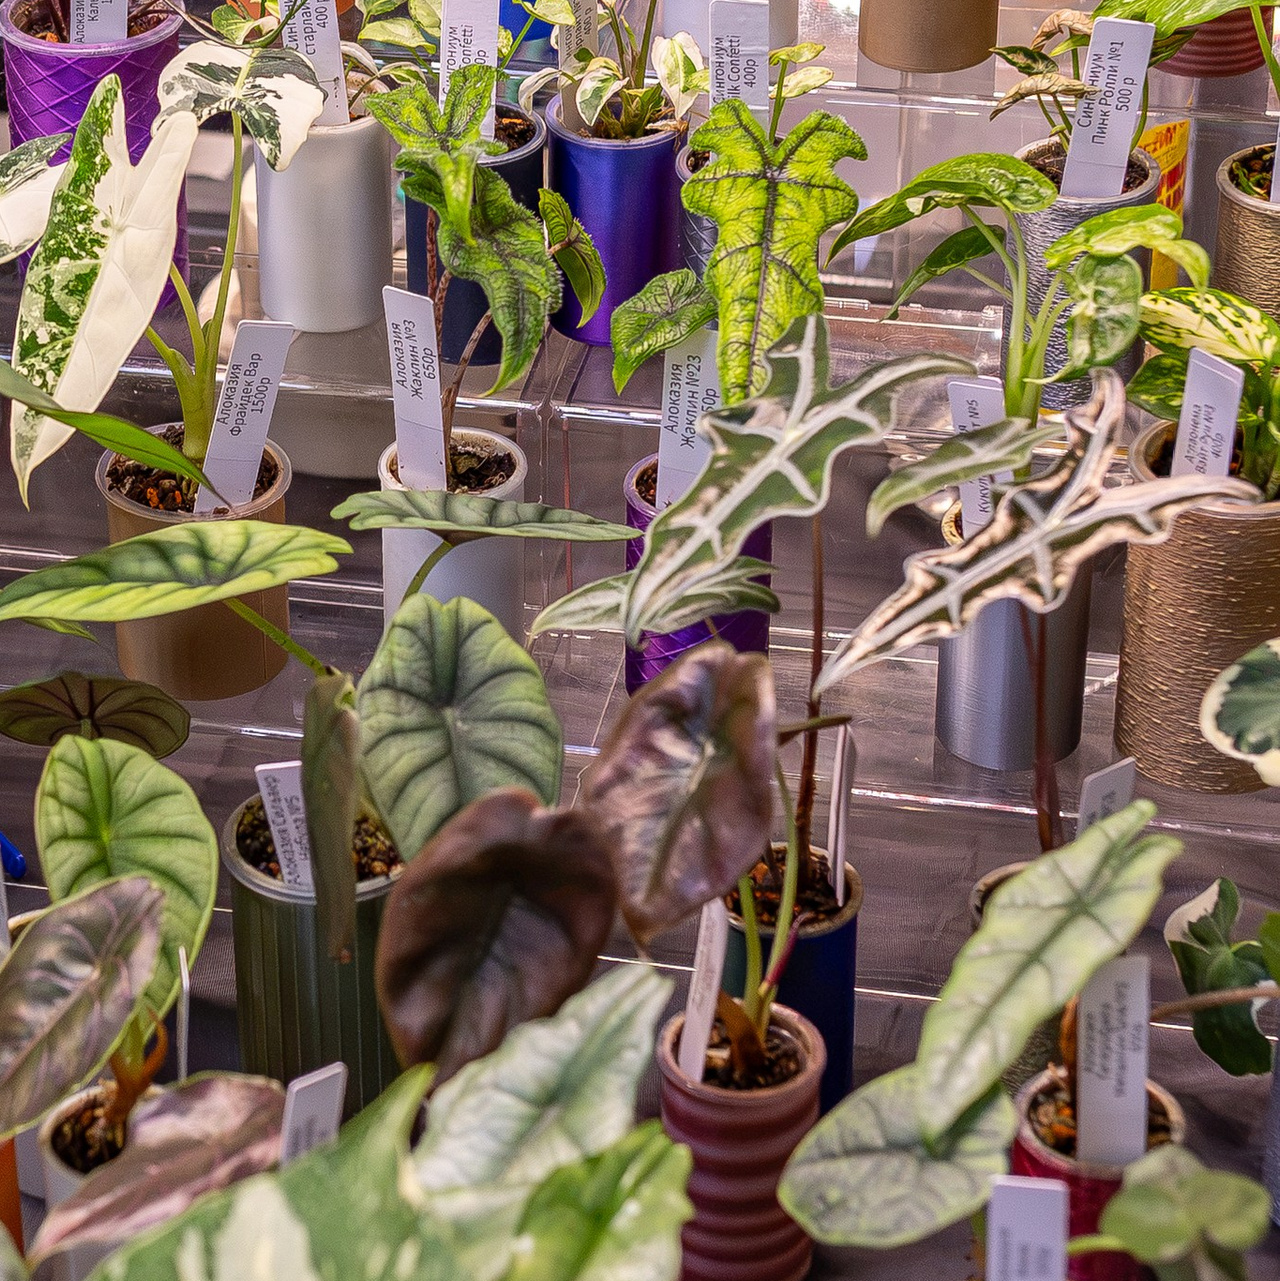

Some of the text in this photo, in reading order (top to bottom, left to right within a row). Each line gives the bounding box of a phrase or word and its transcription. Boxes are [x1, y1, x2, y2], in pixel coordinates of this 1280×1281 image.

[313, 5, 328, 28] 400
[582, 6, 593, 35] 400 р
[713, 37, 729, 103] Сингониум
[727, 35, 740, 97] ilk Confetti
[743, 58, 758, 87] 400р
[1091, 40, 1123, 145] Пинк Ролли №1
[1115, 76, 1137, 112] 500 р
[390, 321, 407, 389] Алоказия
[403, 318, 423, 400] Жаклин №3
[420, 347, 436, 380] 650р
[215, 363, 242, 425] Алоказия
[228, 352, 262, 436] Фрайдек Вар
[250, 376, 272, 414] 1500р
[663, 363, 681, 433] Алоказия
[680, 354, 701, 448] Жаклин №23
[701, 388, 717, 412] 50р
[967, 399, 979, 418] №5
